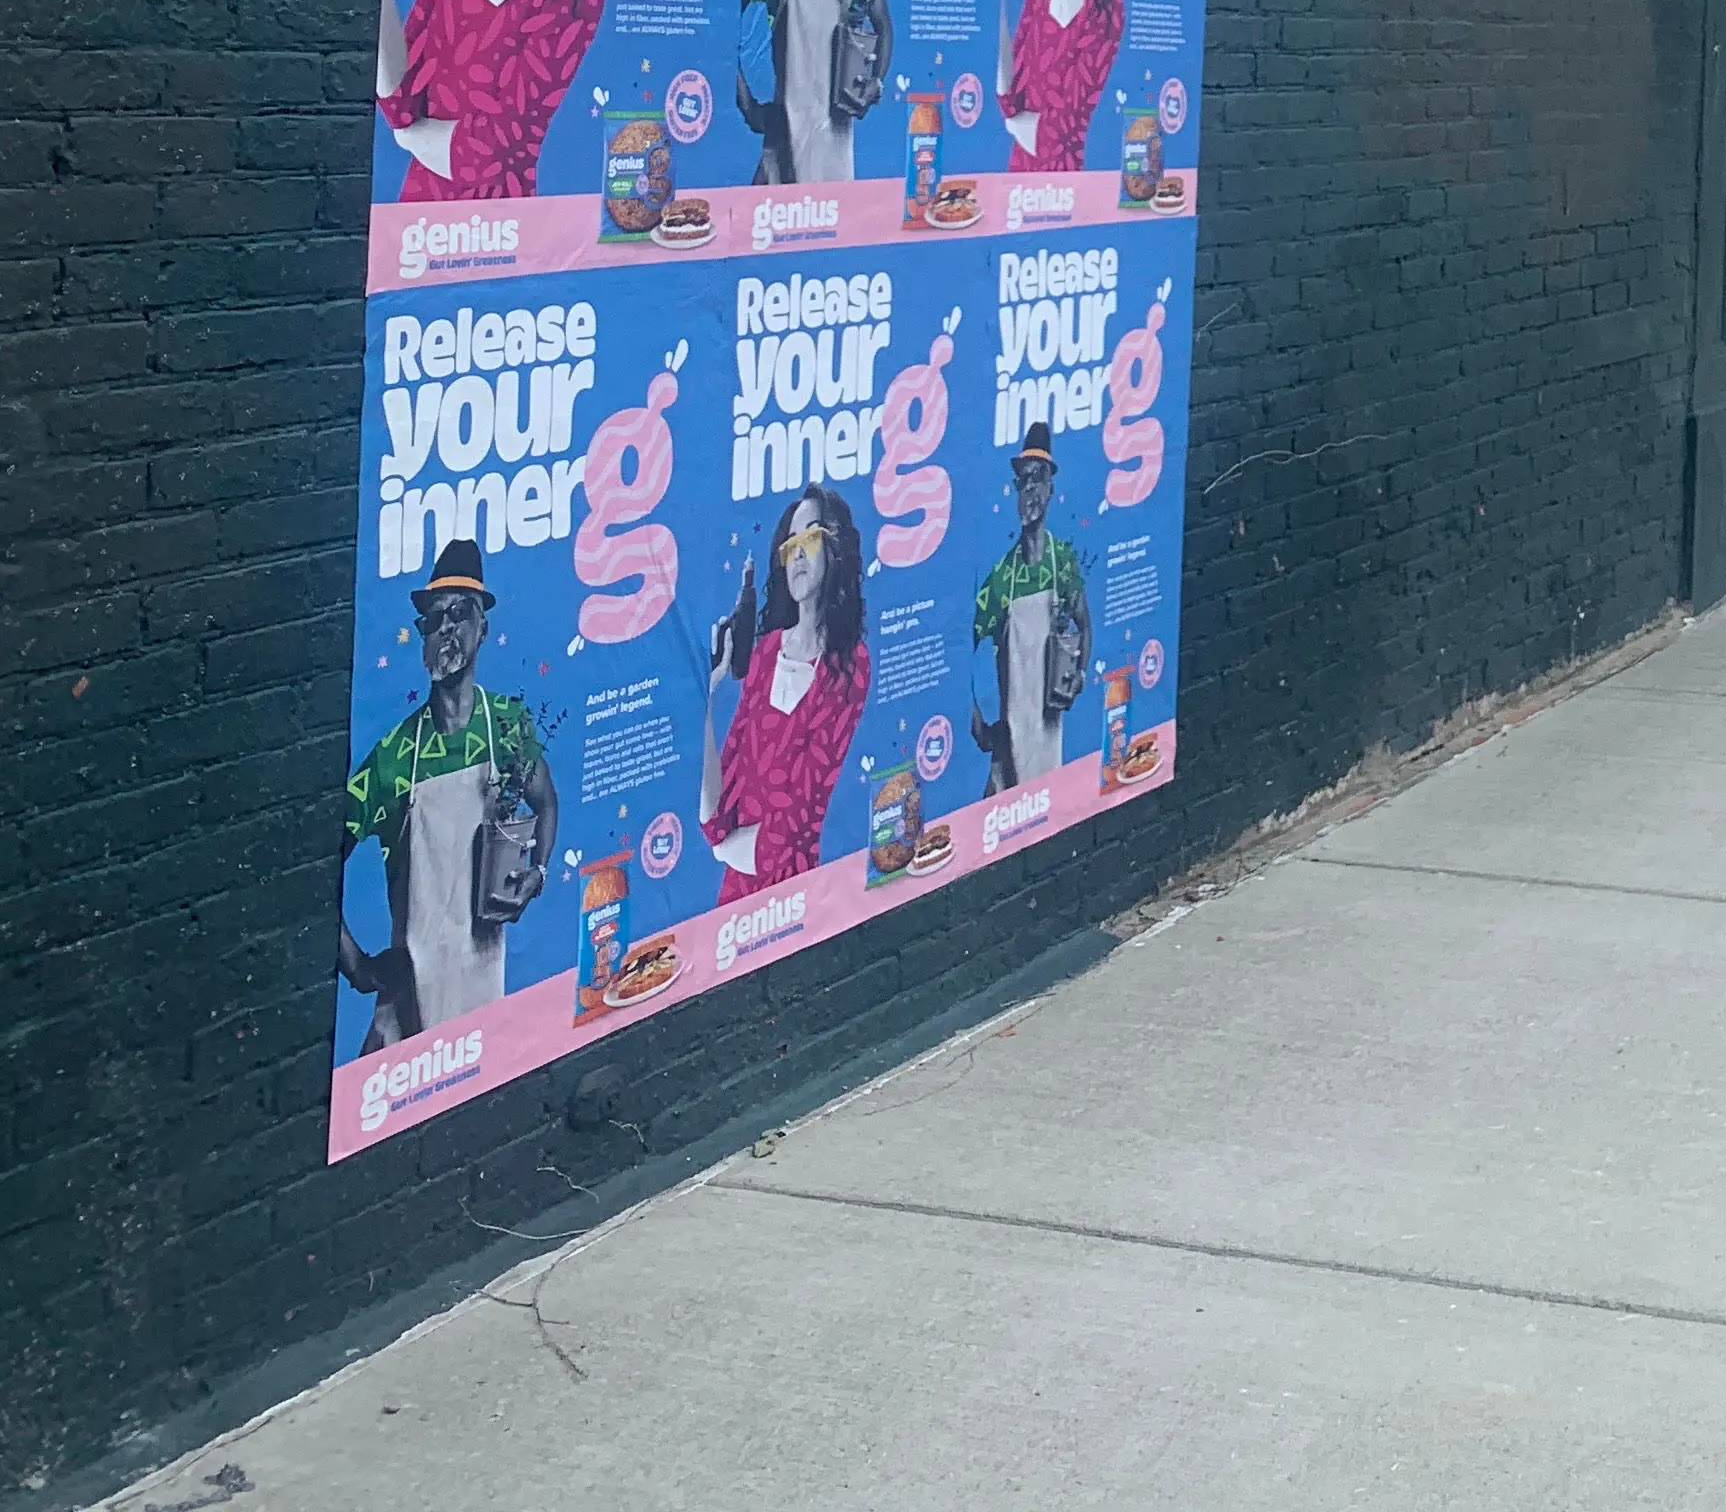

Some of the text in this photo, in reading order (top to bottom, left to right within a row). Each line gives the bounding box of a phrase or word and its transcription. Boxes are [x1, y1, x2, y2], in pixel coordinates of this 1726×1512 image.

[608, 156, 644, 177] genius
[752, 195, 839, 251] genius
[1006, 183, 1074, 230] genius
[399, 215, 519, 279] genius
[999, 247, 1118, 304] Release
[737, 272, 892, 336] Release
[996, 290, 1117, 376] your
[383, 301, 596, 385] Release
[733, 321, 891, 419] your
[380, 359, 594, 481] your
[993, 363, 1112, 447] inner
[731, 403, 884, 502] inner
[379, 455, 586, 579] inner
[586, 677, 659, 706] And be a garden
[621, 694, 653, 713] legend.
[983, 788, 1050, 854] genius
[588, 903, 620, 931] genius
[716, 891, 805, 971] genius
[360, 1029, 483, 1132] genius
